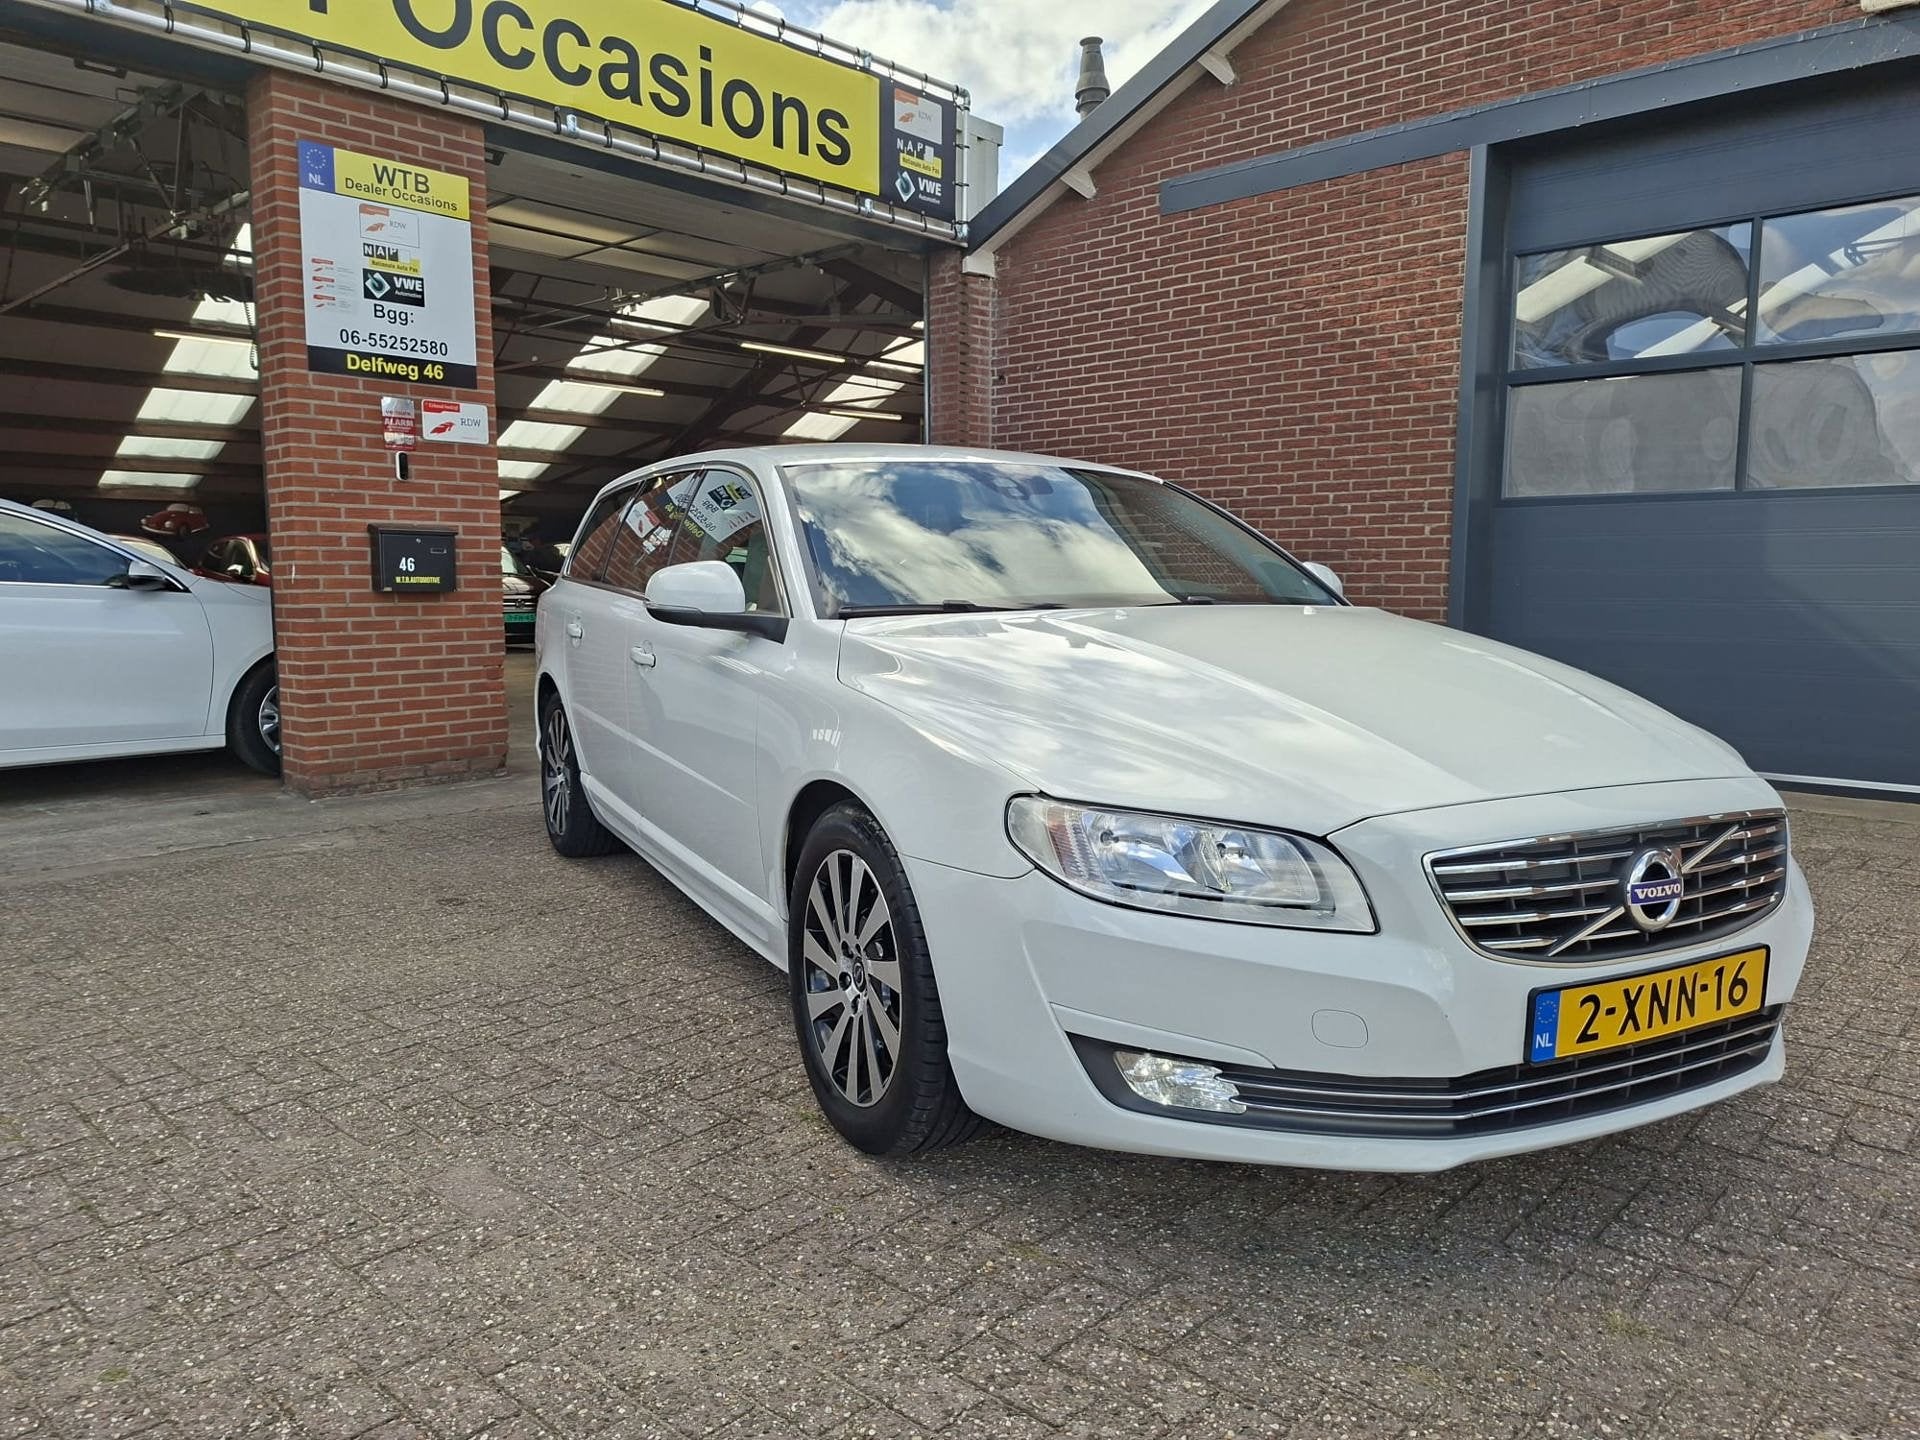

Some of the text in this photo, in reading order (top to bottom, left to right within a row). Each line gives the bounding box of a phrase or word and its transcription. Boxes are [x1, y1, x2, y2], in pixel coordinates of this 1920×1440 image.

[392, 0, 852, 166] Occasions
[308, 173, 325, 186] NL
[373, 163, 430, 194] WTB
[918, 177, 942, 197] VWE
[345, 177, 458, 212] Dealer Occasions
[393, 276, 423, 292] VWE
[374, 303, 414, 326] Bgg:
[340, 329, 448, 356] 06-55252580
[346, 353, 444, 381] Delfweg 46
[460, 417, 481, 428] RDW
[399, 556, 415, 572] 46
[1634, 883, 1681, 900] VOLVO
[1575, 960, 1748, 1045] 2-XNN-16
[1535, 1032, 1553, 1049] NL
